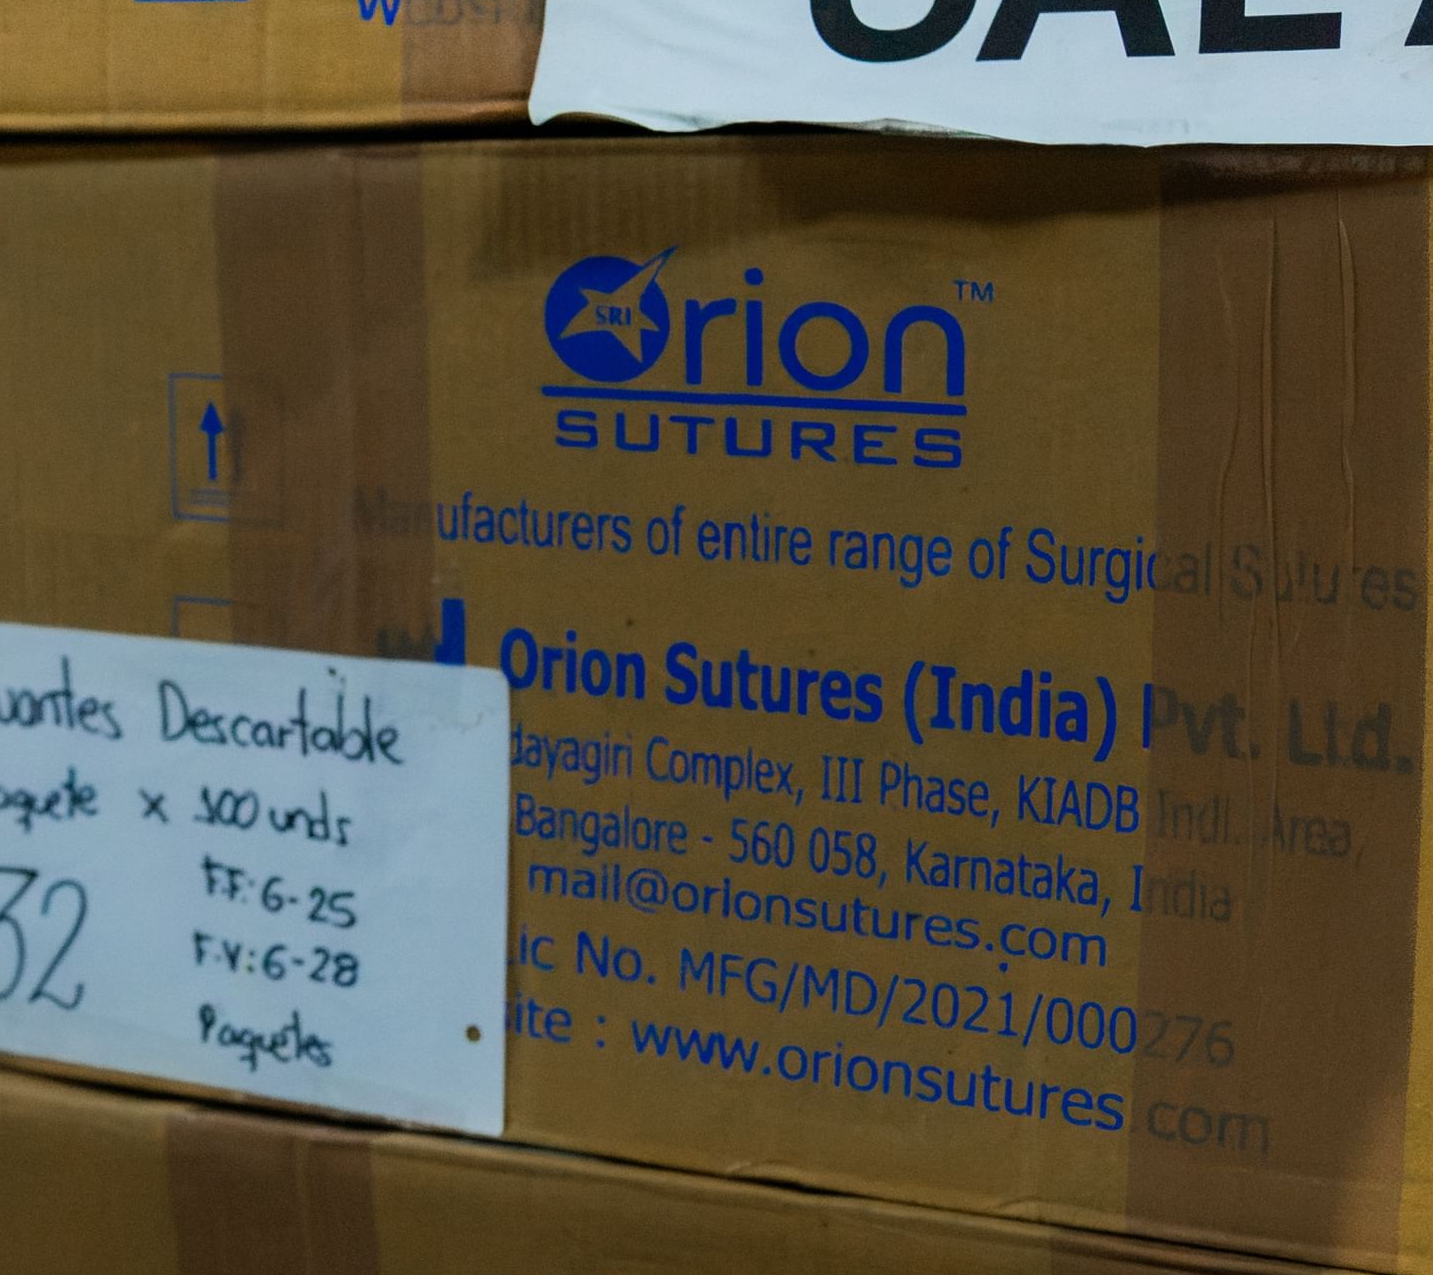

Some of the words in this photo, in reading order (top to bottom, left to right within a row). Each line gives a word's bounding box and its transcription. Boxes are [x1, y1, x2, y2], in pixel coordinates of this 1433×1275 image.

[543, 244, 966, 396] Orion
[555, 409, 963, 469] SUTURES
[647, 504, 687, 556] of
[697, 513, 813, 566] entire
[829, 528, 953, 589] range
[969, 526, 1013, 580] of
[500, 627, 646, 699] Orion
[665, 641, 884, 723] Sutures
[904, 660, 1118, 763] (India)
[510, 723, 633, 786] dayagiri
[646, 735, 804, 807] Complex,
[821, 755, 865, 805] III
[880, 760, 1001, 828] Phase,
[1018, 774, 1140, 834] KIADB
[516, 792, 688, 857] Bangalore
[729, 817, 795, 868] 560
[809, 827, 887, 890] 058,
[906, 837, 1111, 918] Karnataka,
[508, 924, 554, 971] ic
[577, 930, 656, 984] No.
